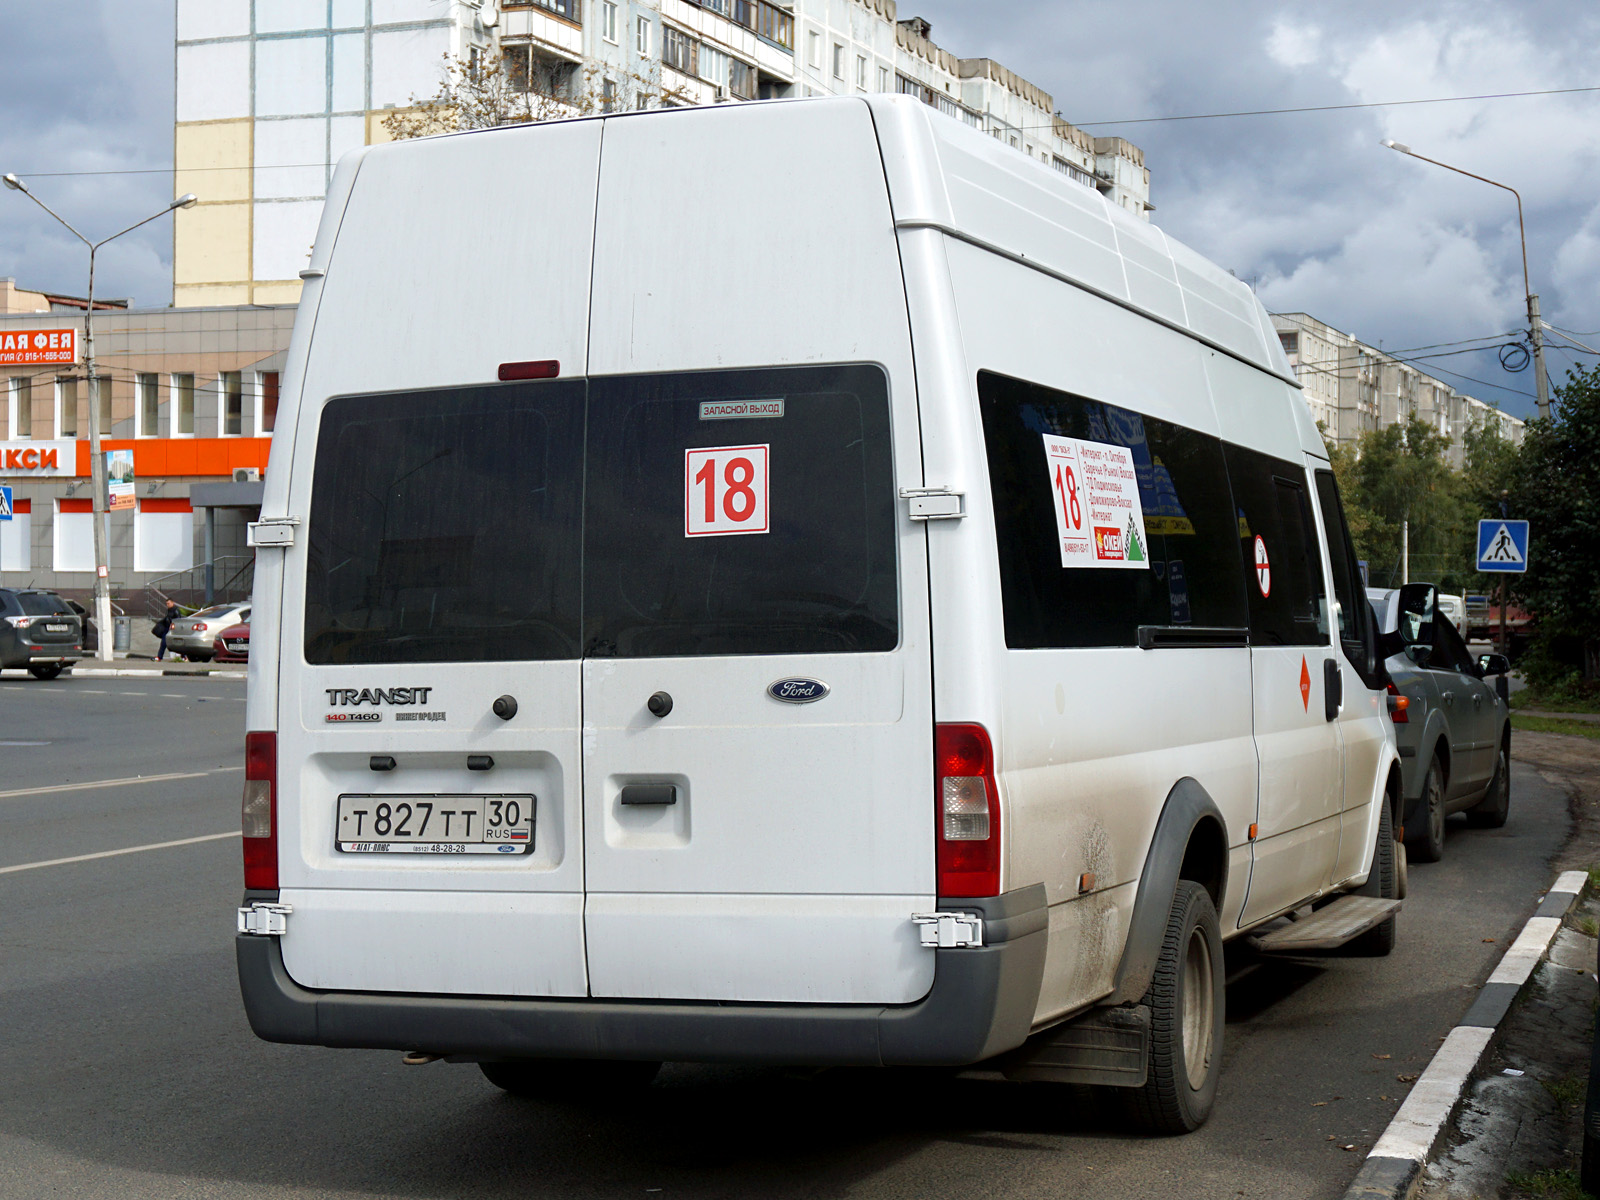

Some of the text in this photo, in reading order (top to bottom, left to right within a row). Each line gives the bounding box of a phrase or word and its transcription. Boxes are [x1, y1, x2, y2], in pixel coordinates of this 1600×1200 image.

[34, 333, 71, 349] ФЕЯ
[703, 403, 780, 416] ЗАПАСНОЙ ВЫХОД
[0, 448, 58, 470] КСИ
[1119, 466, 1134, 480] Вокзал
[696, 457, 756, 523] 18
[1056, 464, 1081, 531] 18
[325, 687, 432, 706] TRANSIT
[780, 681, 816, 697] Ford
[326, 713, 380, 721] 140 T460
[395, 711, 447, 722] НИЖЕГОРОДЕЦ
[488, 800, 520, 827] 30
[486, 830, 510, 839] RUS
[430, 844, 466, 853] 48-28-28
